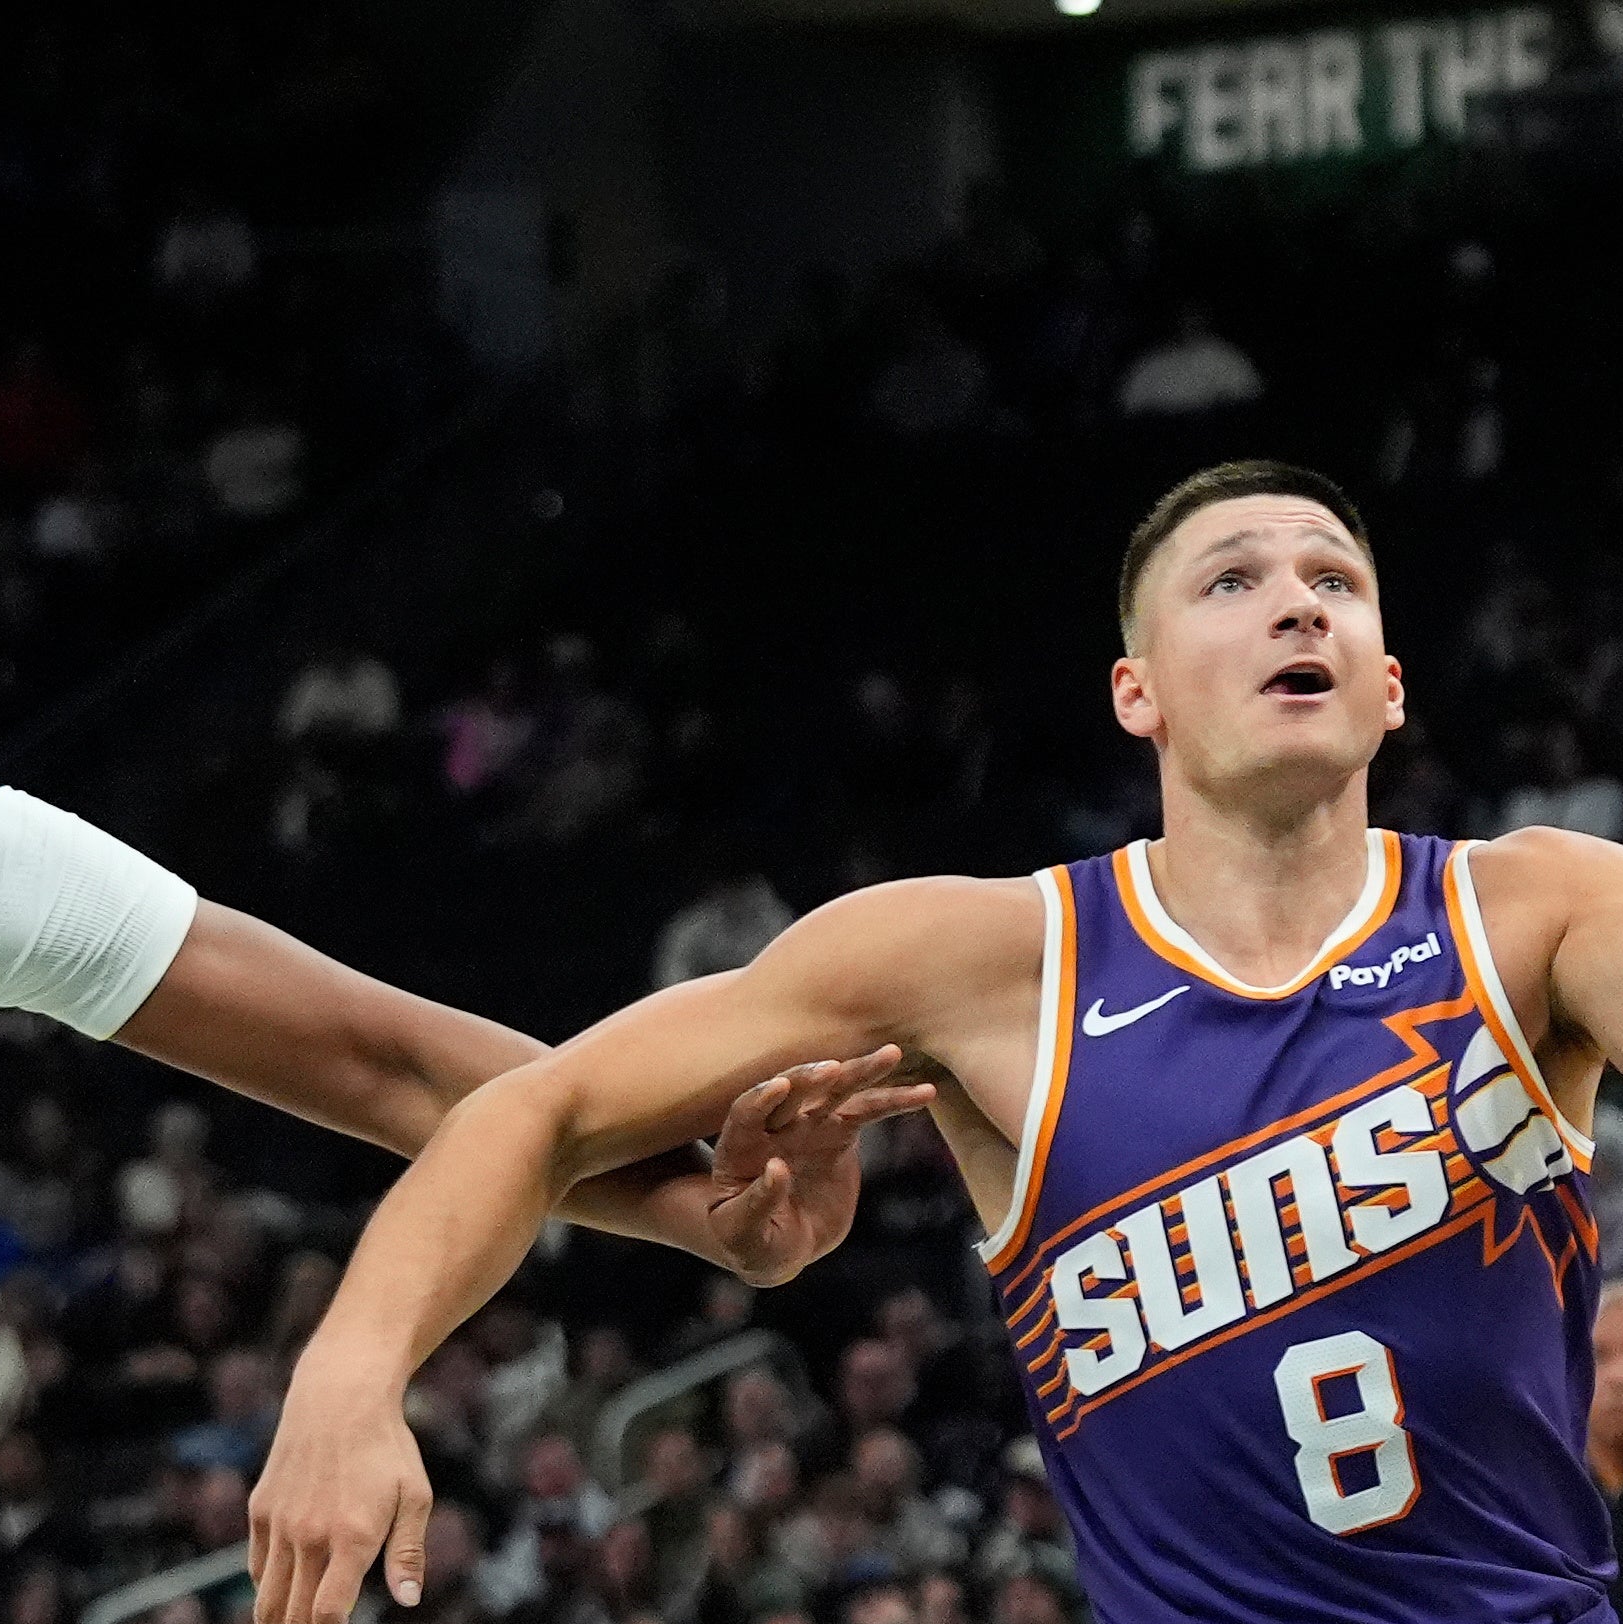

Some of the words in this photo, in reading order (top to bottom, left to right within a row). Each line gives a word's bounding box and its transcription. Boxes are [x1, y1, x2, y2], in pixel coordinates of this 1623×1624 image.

[1127, 28, 1366, 172] FEAR
[1329, 931, 1442, 991] PayPal
[1273, 1330, 1422, 1537] 8
